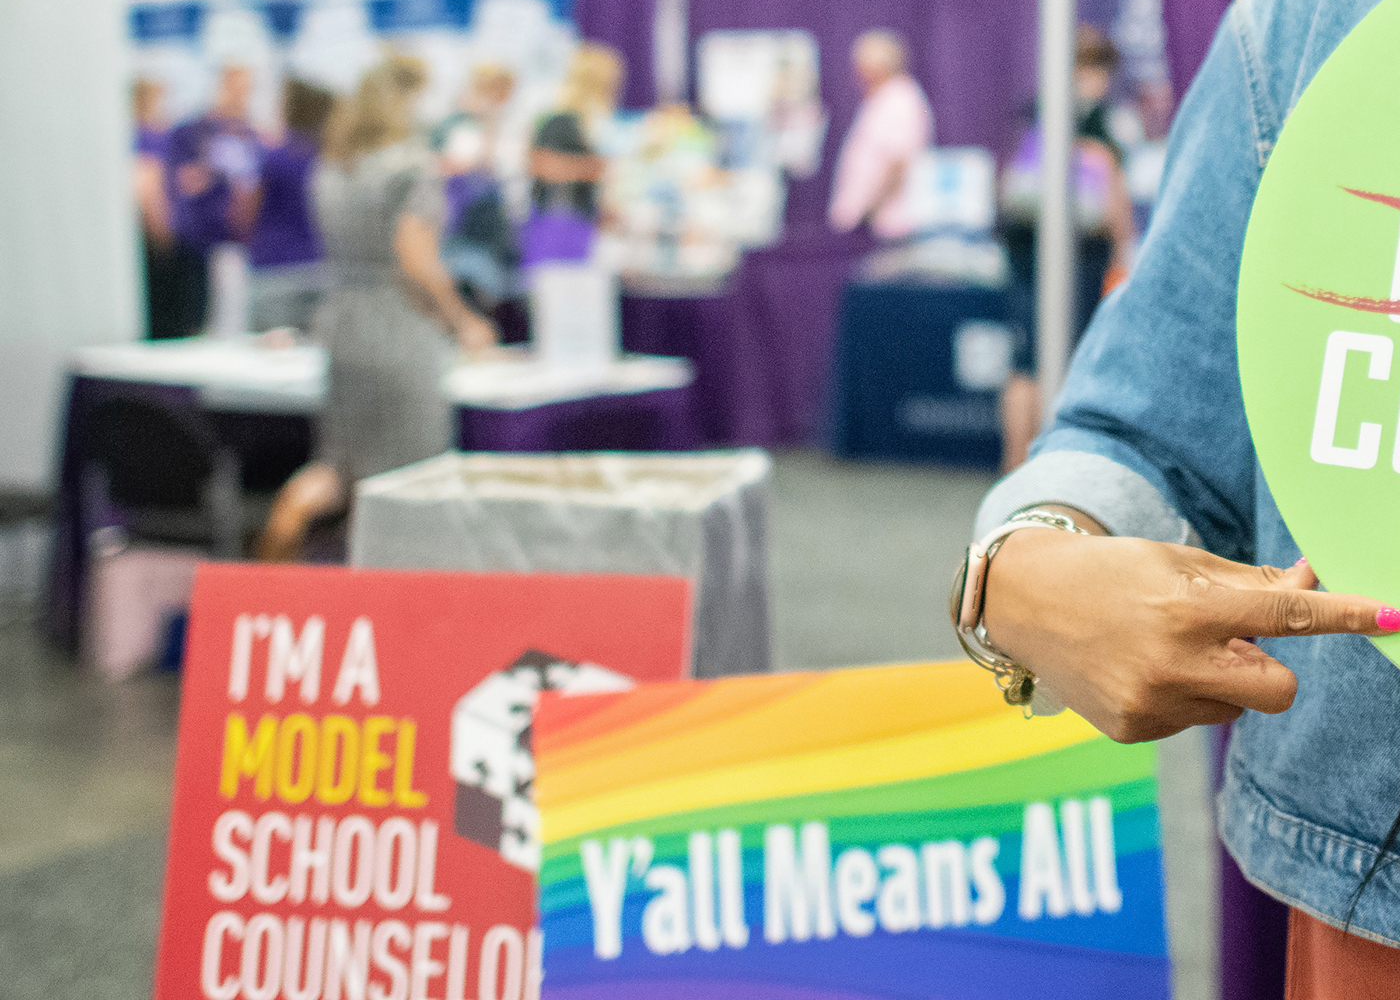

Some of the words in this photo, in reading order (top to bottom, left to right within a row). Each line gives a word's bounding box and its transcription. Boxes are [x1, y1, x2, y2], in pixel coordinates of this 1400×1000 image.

[228, 613, 325, 704] I'M
[332, 616, 380, 706] A
[219, 713, 428, 807] MODEL
[208, 810, 452, 912] SCHOOL
[581, 834, 749, 959] Y'all
[764, 821, 1005, 944] Means
[1018, 797, 1122, 920] All
